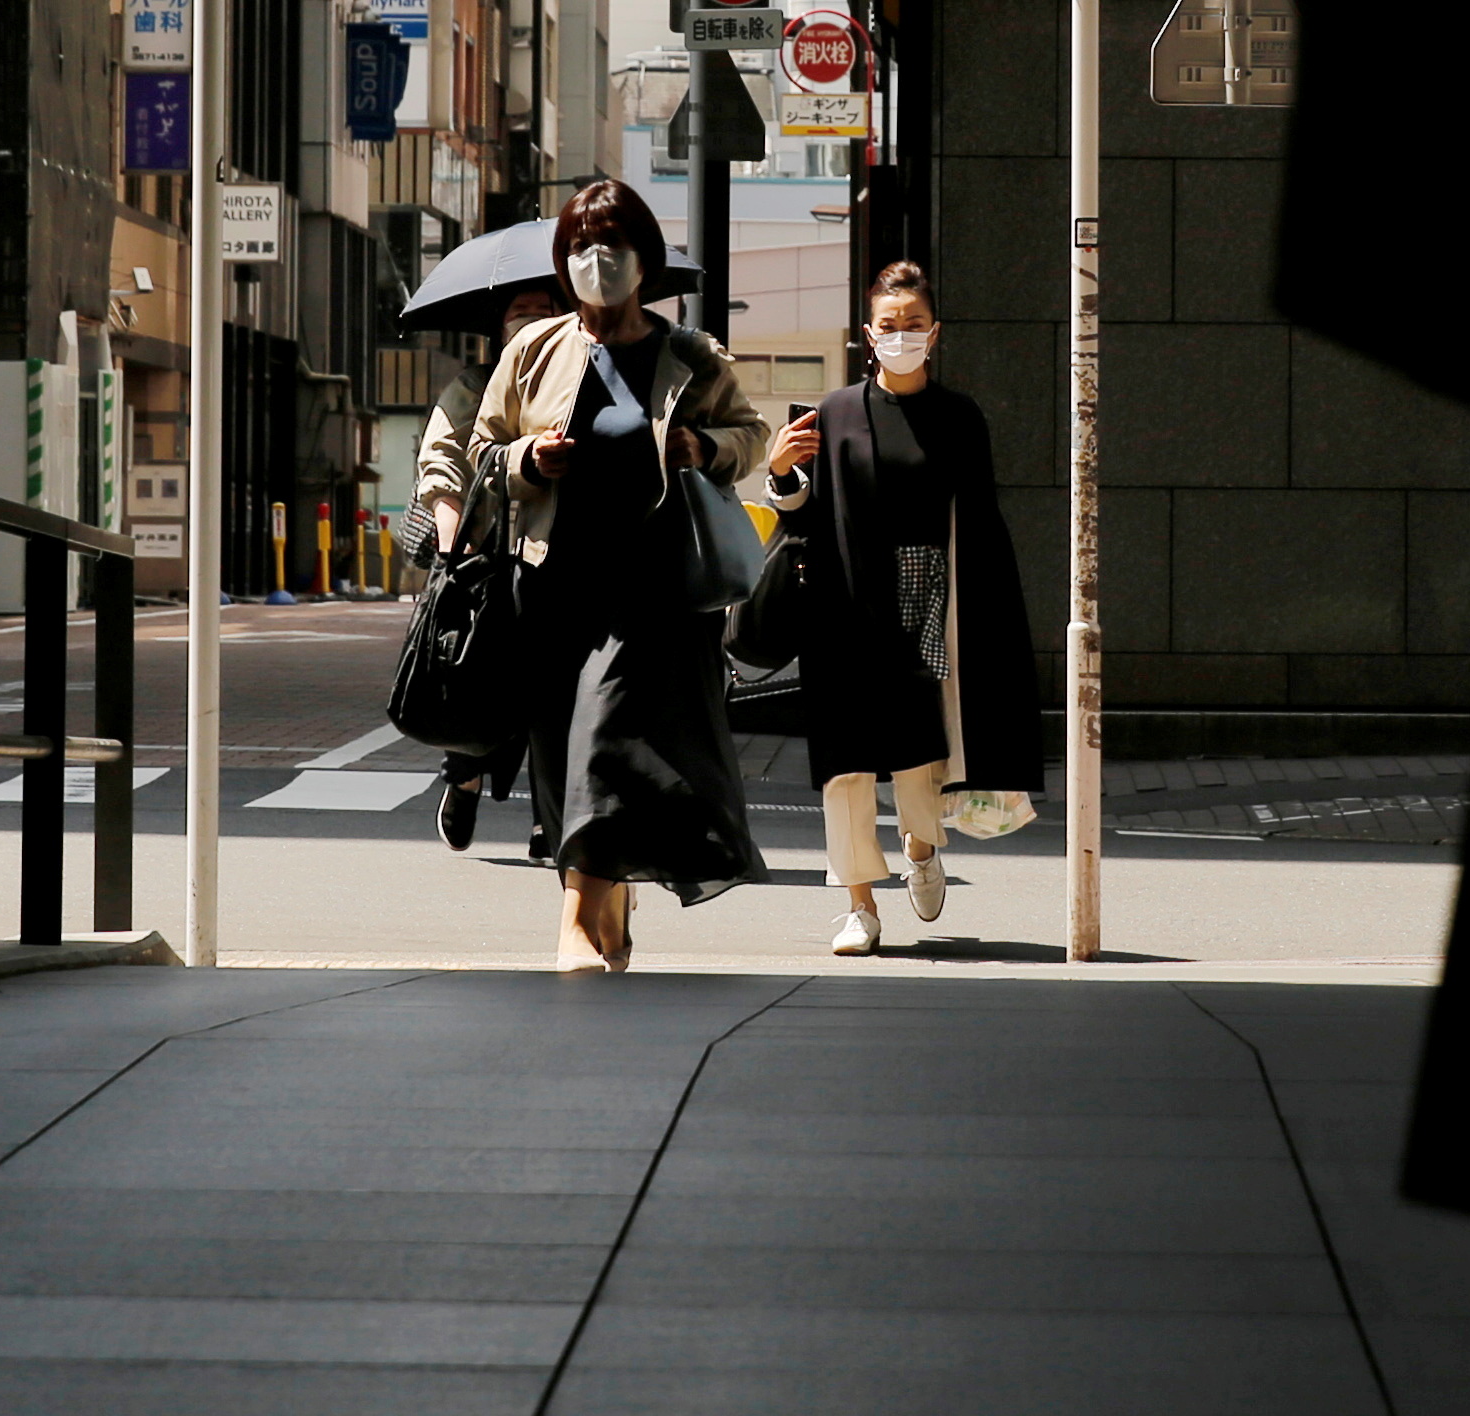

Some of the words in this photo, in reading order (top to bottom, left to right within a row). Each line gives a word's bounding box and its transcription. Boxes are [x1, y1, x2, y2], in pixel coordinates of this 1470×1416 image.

[134, 11, 184, 34] 歯科
[693, 17, 774, 41] 自転車を除く
[799, 41, 850, 64] 消火栓
[355, 43, 378, 111] Soup
[814, 99, 848, 110] ギンザ
[223, 210, 272, 221] ALLERY
[223, 241, 274, 253] ロタ画廊
